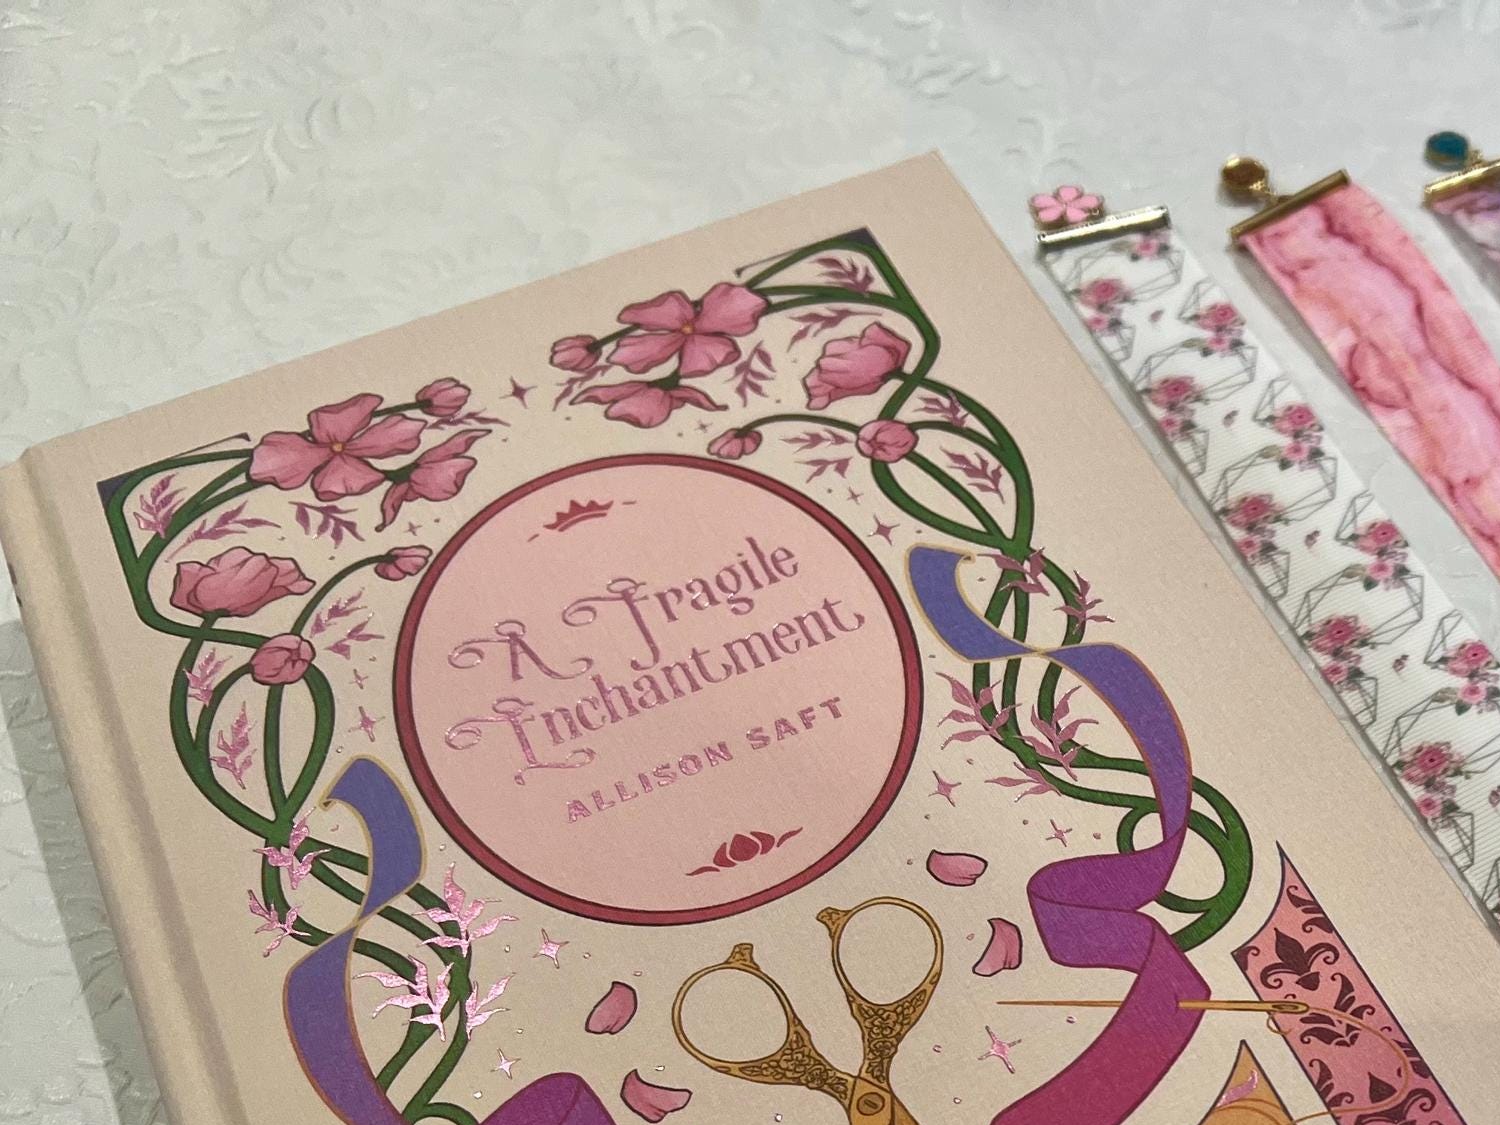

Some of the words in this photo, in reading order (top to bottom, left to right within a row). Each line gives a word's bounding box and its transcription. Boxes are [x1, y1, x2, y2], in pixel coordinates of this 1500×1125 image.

[447, 619, 594, 681] A
[561, 536, 801, 671] Fragile
[444, 597, 866, 786] Enchantment
[566, 741, 734, 824] ALLISON
[745, 696, 843, 751] SAFT
